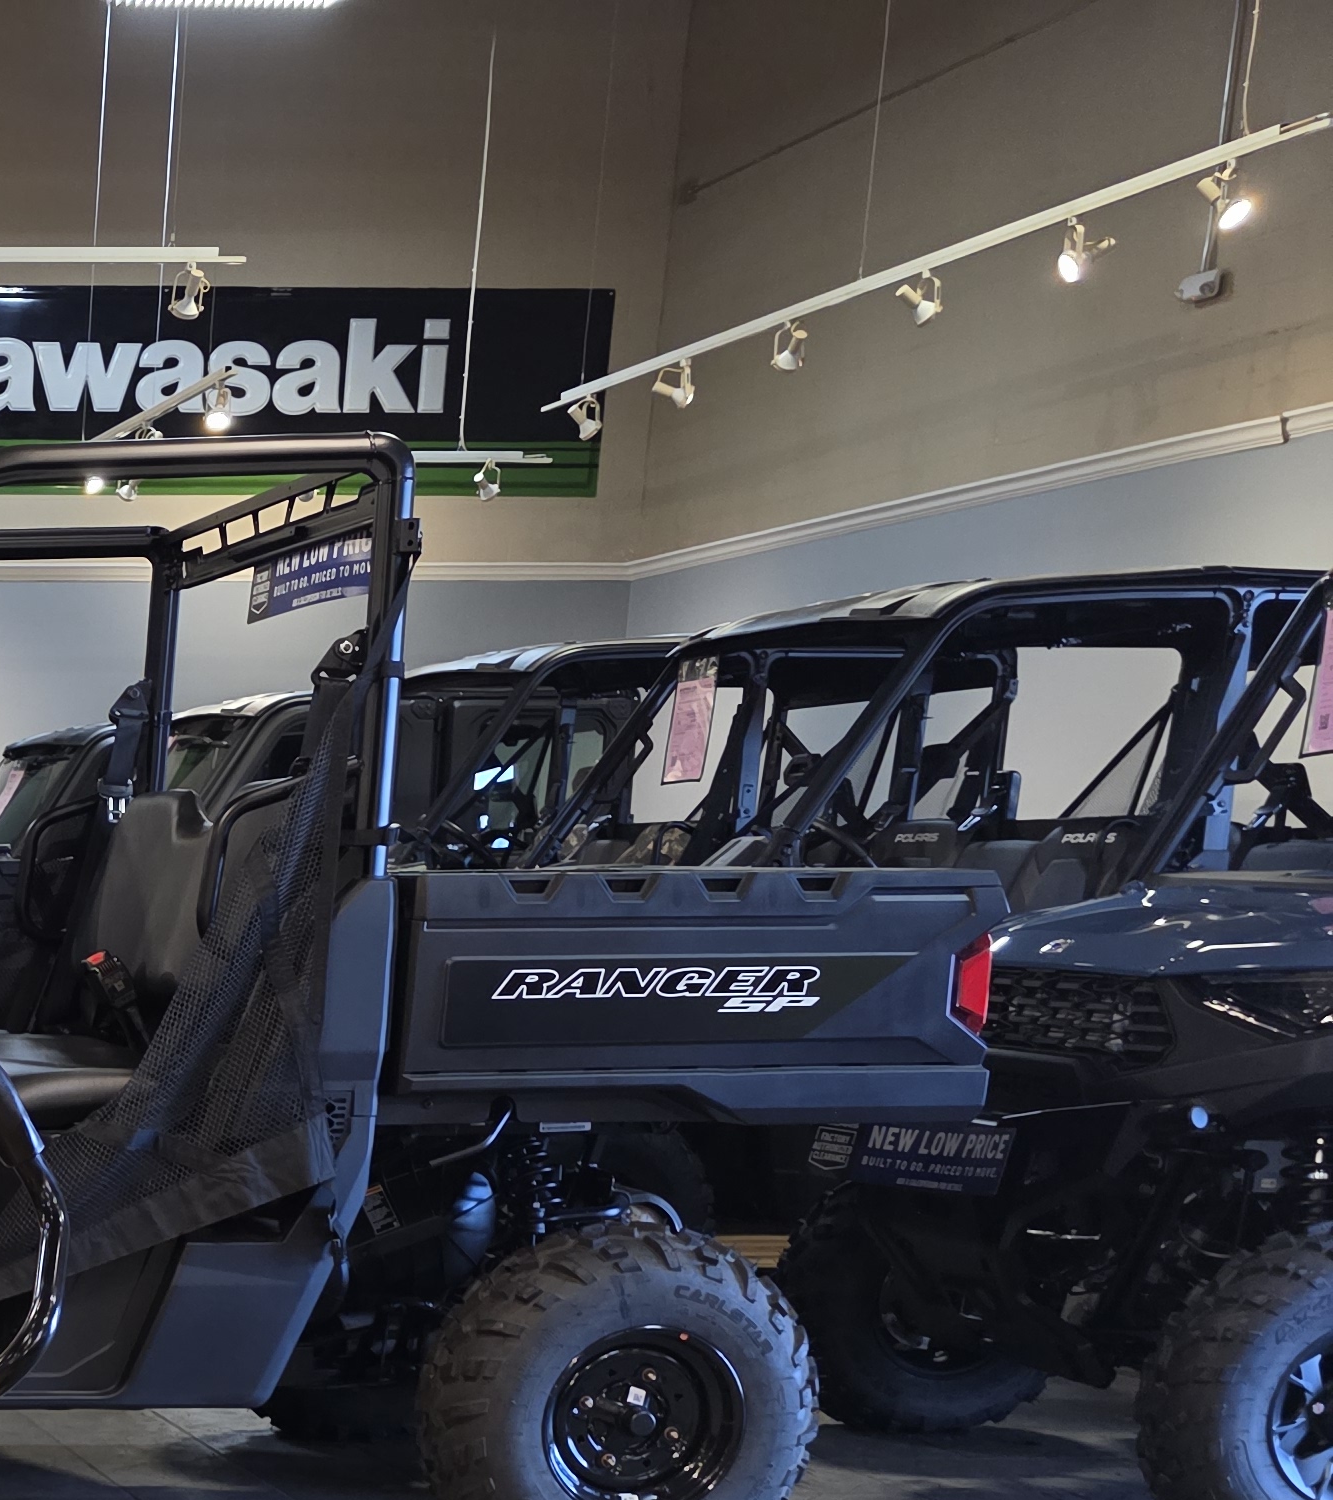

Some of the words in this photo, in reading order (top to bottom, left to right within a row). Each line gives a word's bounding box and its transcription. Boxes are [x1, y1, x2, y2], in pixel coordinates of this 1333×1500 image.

[333, 535, 372, 559] PRIC
[310, 568, 336, 586] PRICED
[340, 565, 349, 578] TO
[353, 560, 371, 576] MOV
[894, 832, 940, 843] POLARIS
[1061, 832, 1117, 843] POLARS
[491, 966, 820, 999] RANGER
[717, 997, 821, 1012] SP
[820, 1131, 851, 1143] FACTORY
[868, 1125, 919, 1152] NEW
[918, 1130, 964, 1157] LOW
[962, 1134, 1010, 1159] PRICE
[861, 1155, 891, 1168] BUILT
[895, 1159, 907, 1170] TO
[928, 1163, 963, 1176] PRICED
[964, 1166, 974, 1177] TO
